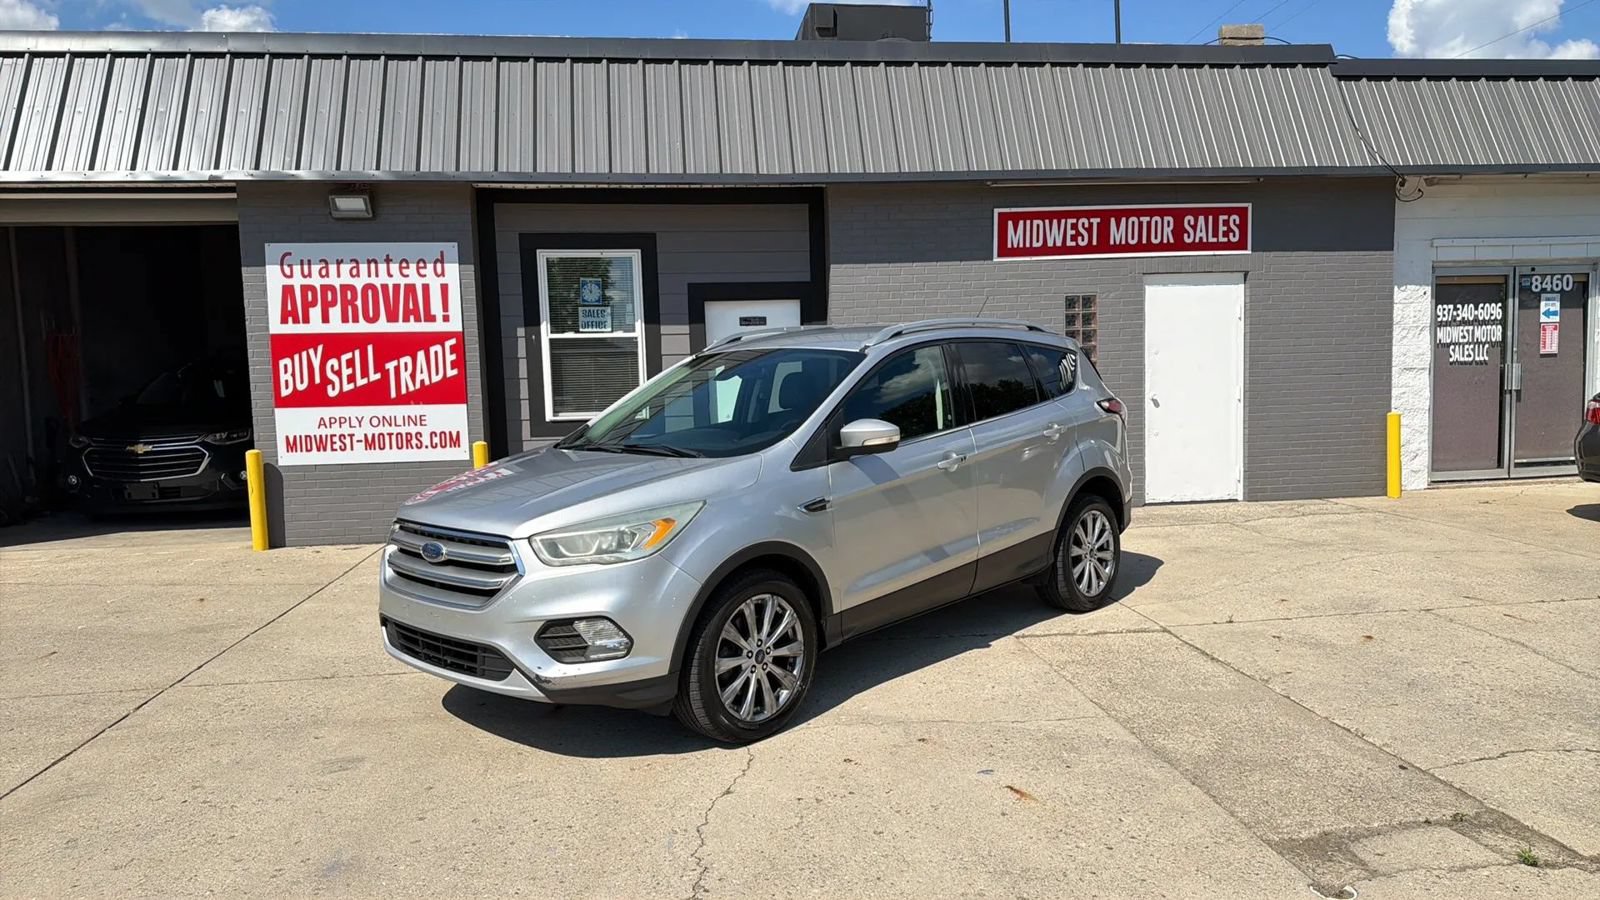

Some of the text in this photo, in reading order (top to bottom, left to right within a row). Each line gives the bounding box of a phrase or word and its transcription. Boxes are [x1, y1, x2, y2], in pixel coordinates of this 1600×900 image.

[1007, 215, 1240, 248] MIDWEST MOTOR SALES
[279, 250, 446, 279] Guaranteed
[1531, 274, 1573, 292] 8460
[280, 283, 450, 325] APPROVAL!
[1436, 303, 1502, 321] 937-340-6096
[582, 309, 606, 319] SALES
[581, 320, 608, 329] OFFICE
[1436, 324, 1502, 344] MIDWEST MOTOR
[1449, 343, 1489, 362] SALES LLC
[278, 337, 459, 399] BUY SELL TRADE
[317, 414, 427, 429] APPLY ONLINE
[285, 431, 461, 453] MIDWEST-MOTORS.COM
